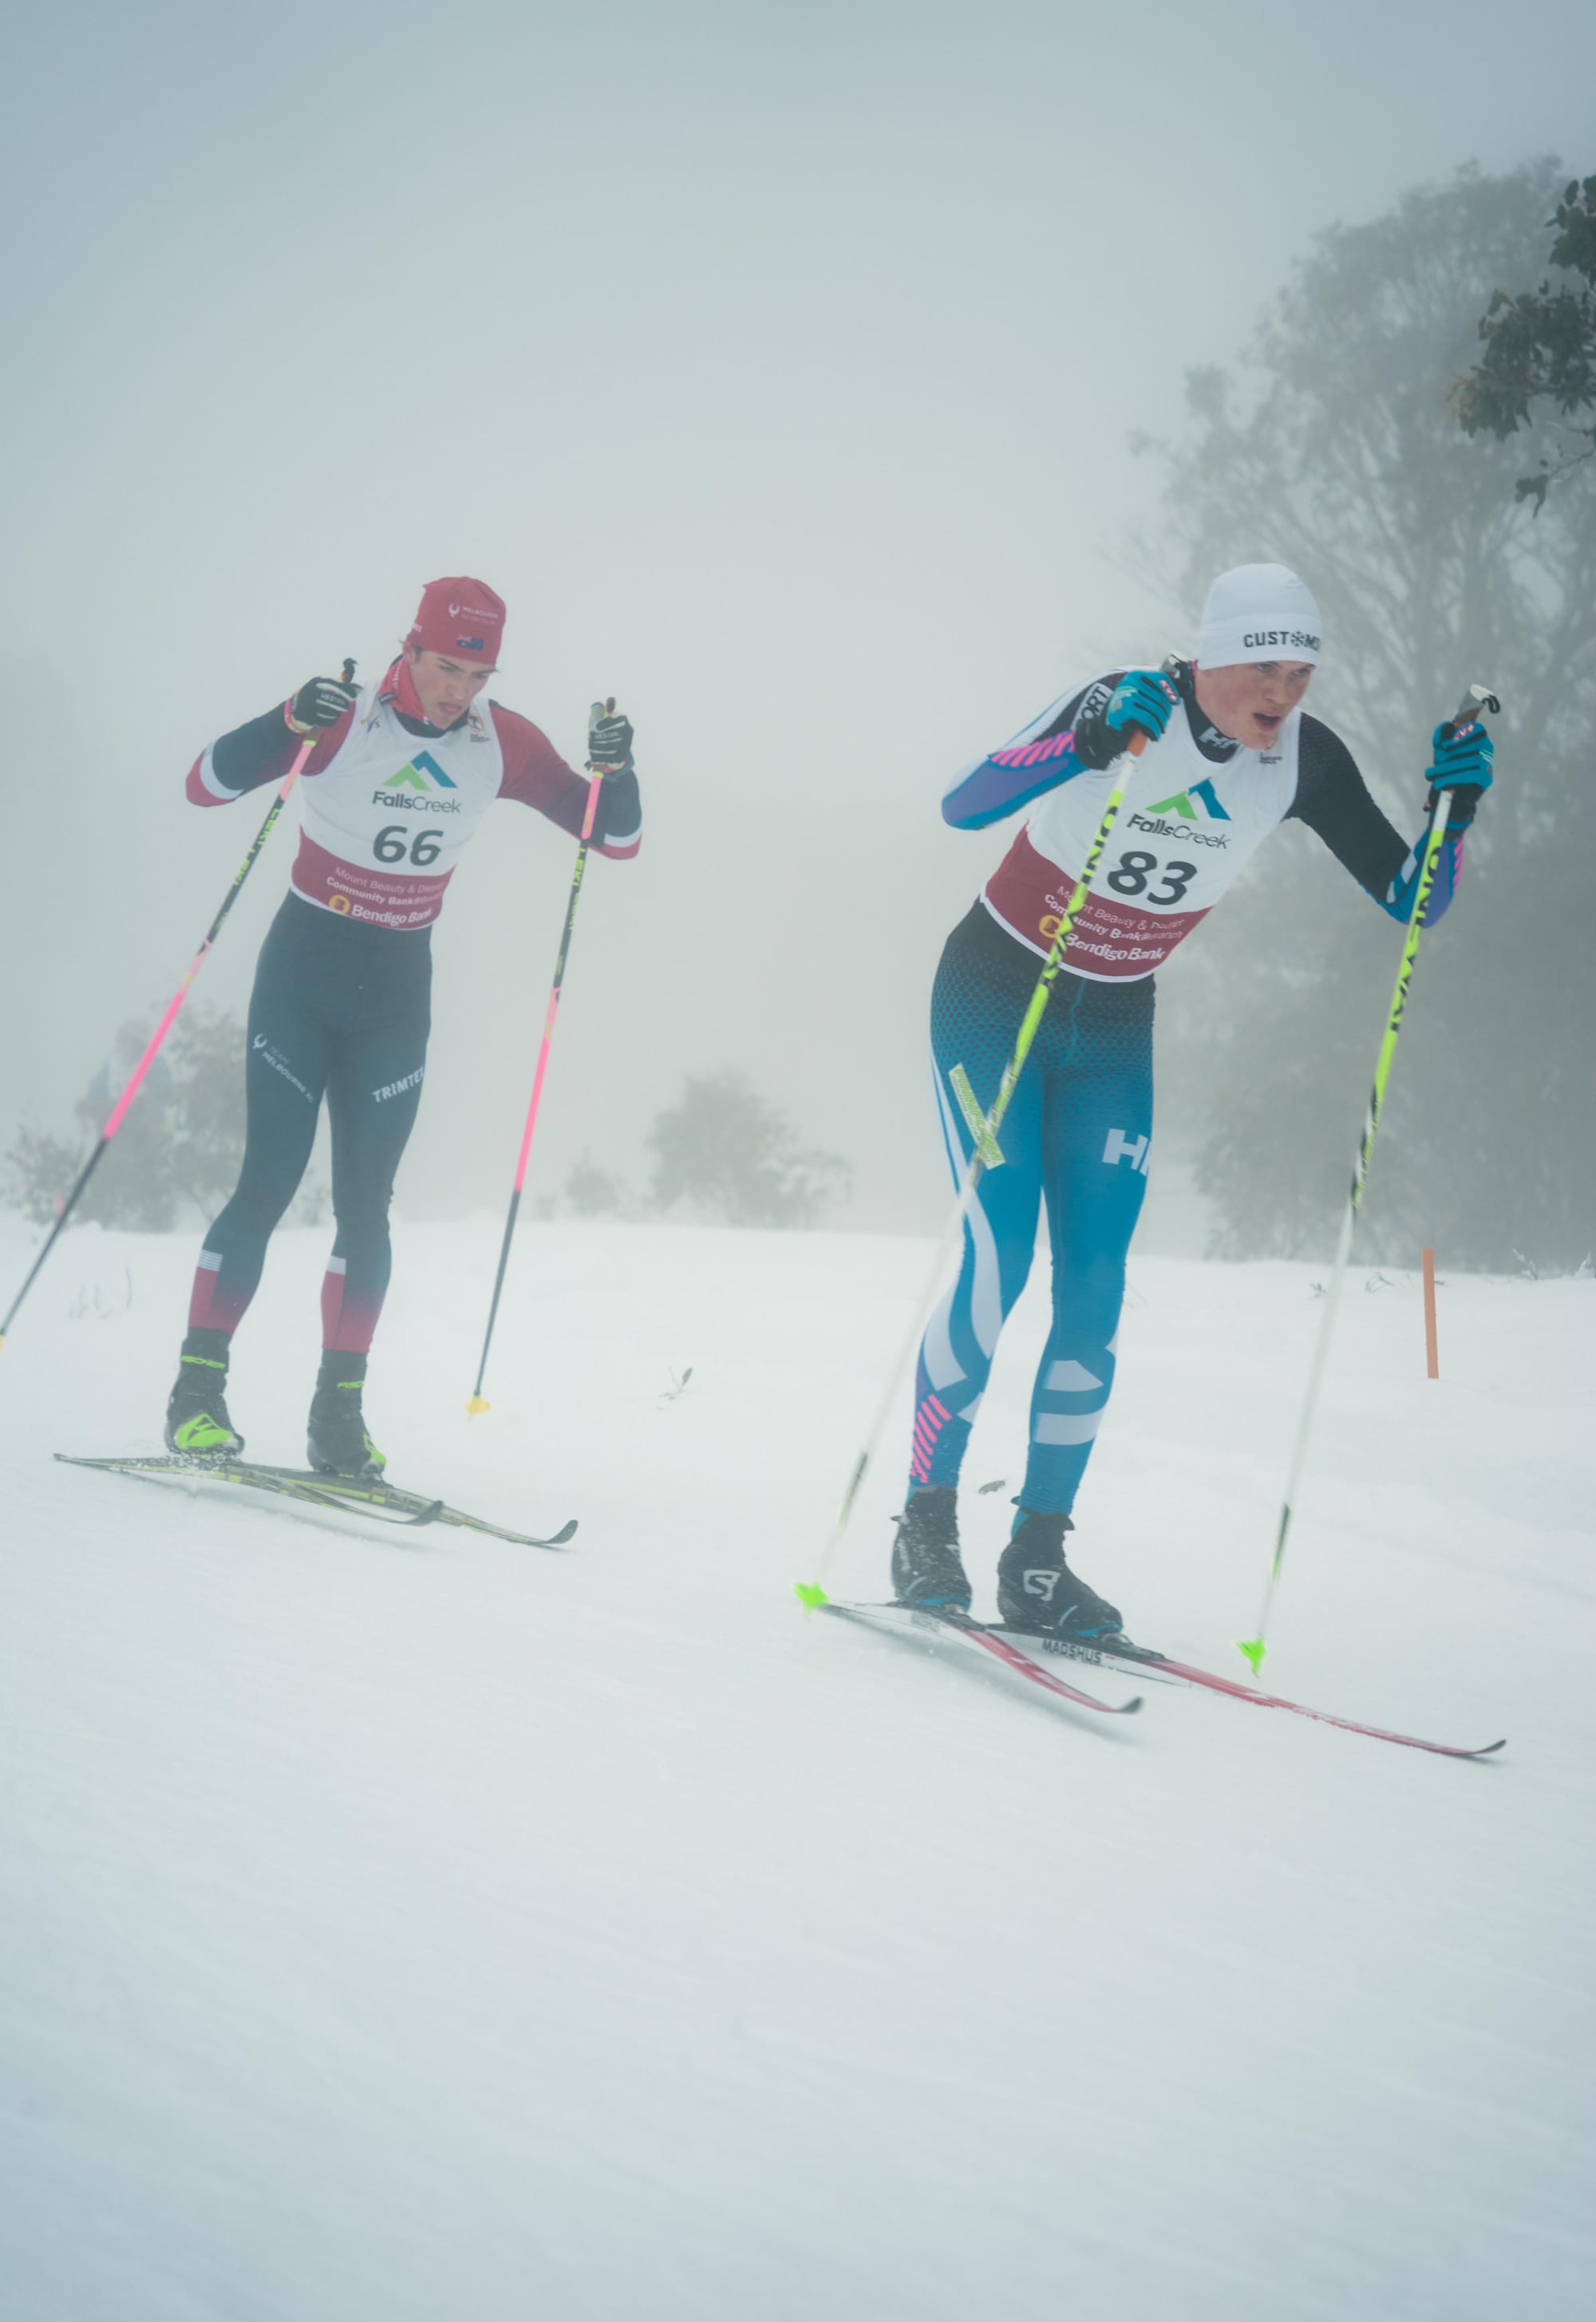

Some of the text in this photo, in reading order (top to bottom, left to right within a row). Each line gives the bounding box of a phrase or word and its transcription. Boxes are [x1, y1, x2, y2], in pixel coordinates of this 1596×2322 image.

[373, 825, 444, 867] 66
[326, 877, 385, 904] Community
[335, 867, 367, 887] Mount
[370, 881, 405, 894] Beauty
[1108, 851, 1198, 906] 83
[352, 905, 433, 926] Bendigo Bank
[1094, 908, 1136, 928] Beauty
[1137, 920, 1148, 930] &
[1066, 933, 1166, 961] Bendigo Bank
[262, 1051, 306, 1094] MELBOURNE
[1042, 1638, 1102, 1664] MADSHUS
